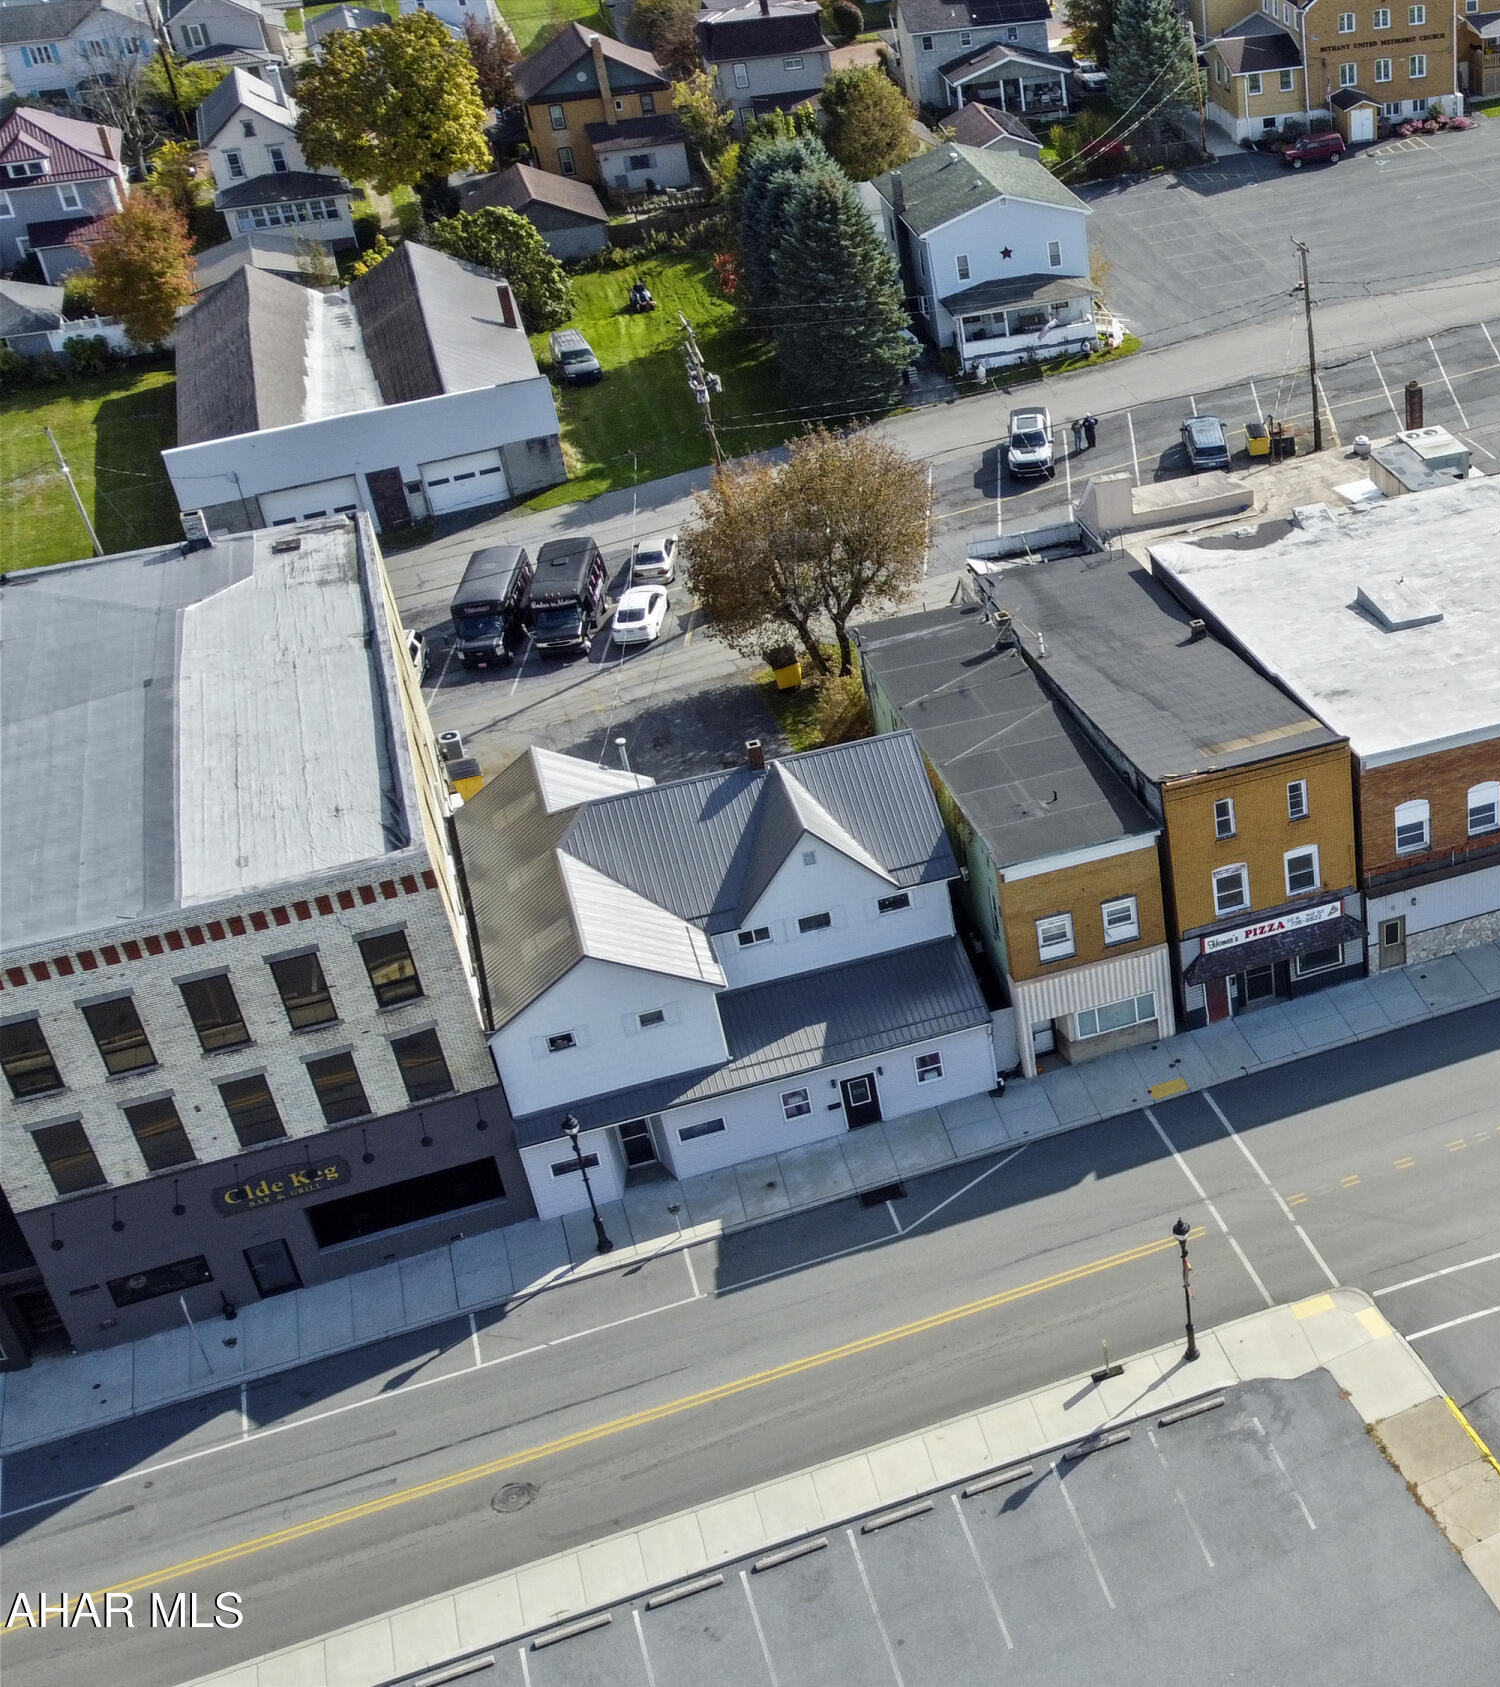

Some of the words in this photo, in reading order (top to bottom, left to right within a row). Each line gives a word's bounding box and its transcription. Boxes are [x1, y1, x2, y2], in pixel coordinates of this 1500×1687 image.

[1354, 40, 1378, 48] UNITED
[1419, 33, 1445, 41] CHURCH
[1244, 921, 1285, 939] PIZZA
[248, 1197, 271, 1208] BAR
[290, 1183, 322, 1197] GRILL
